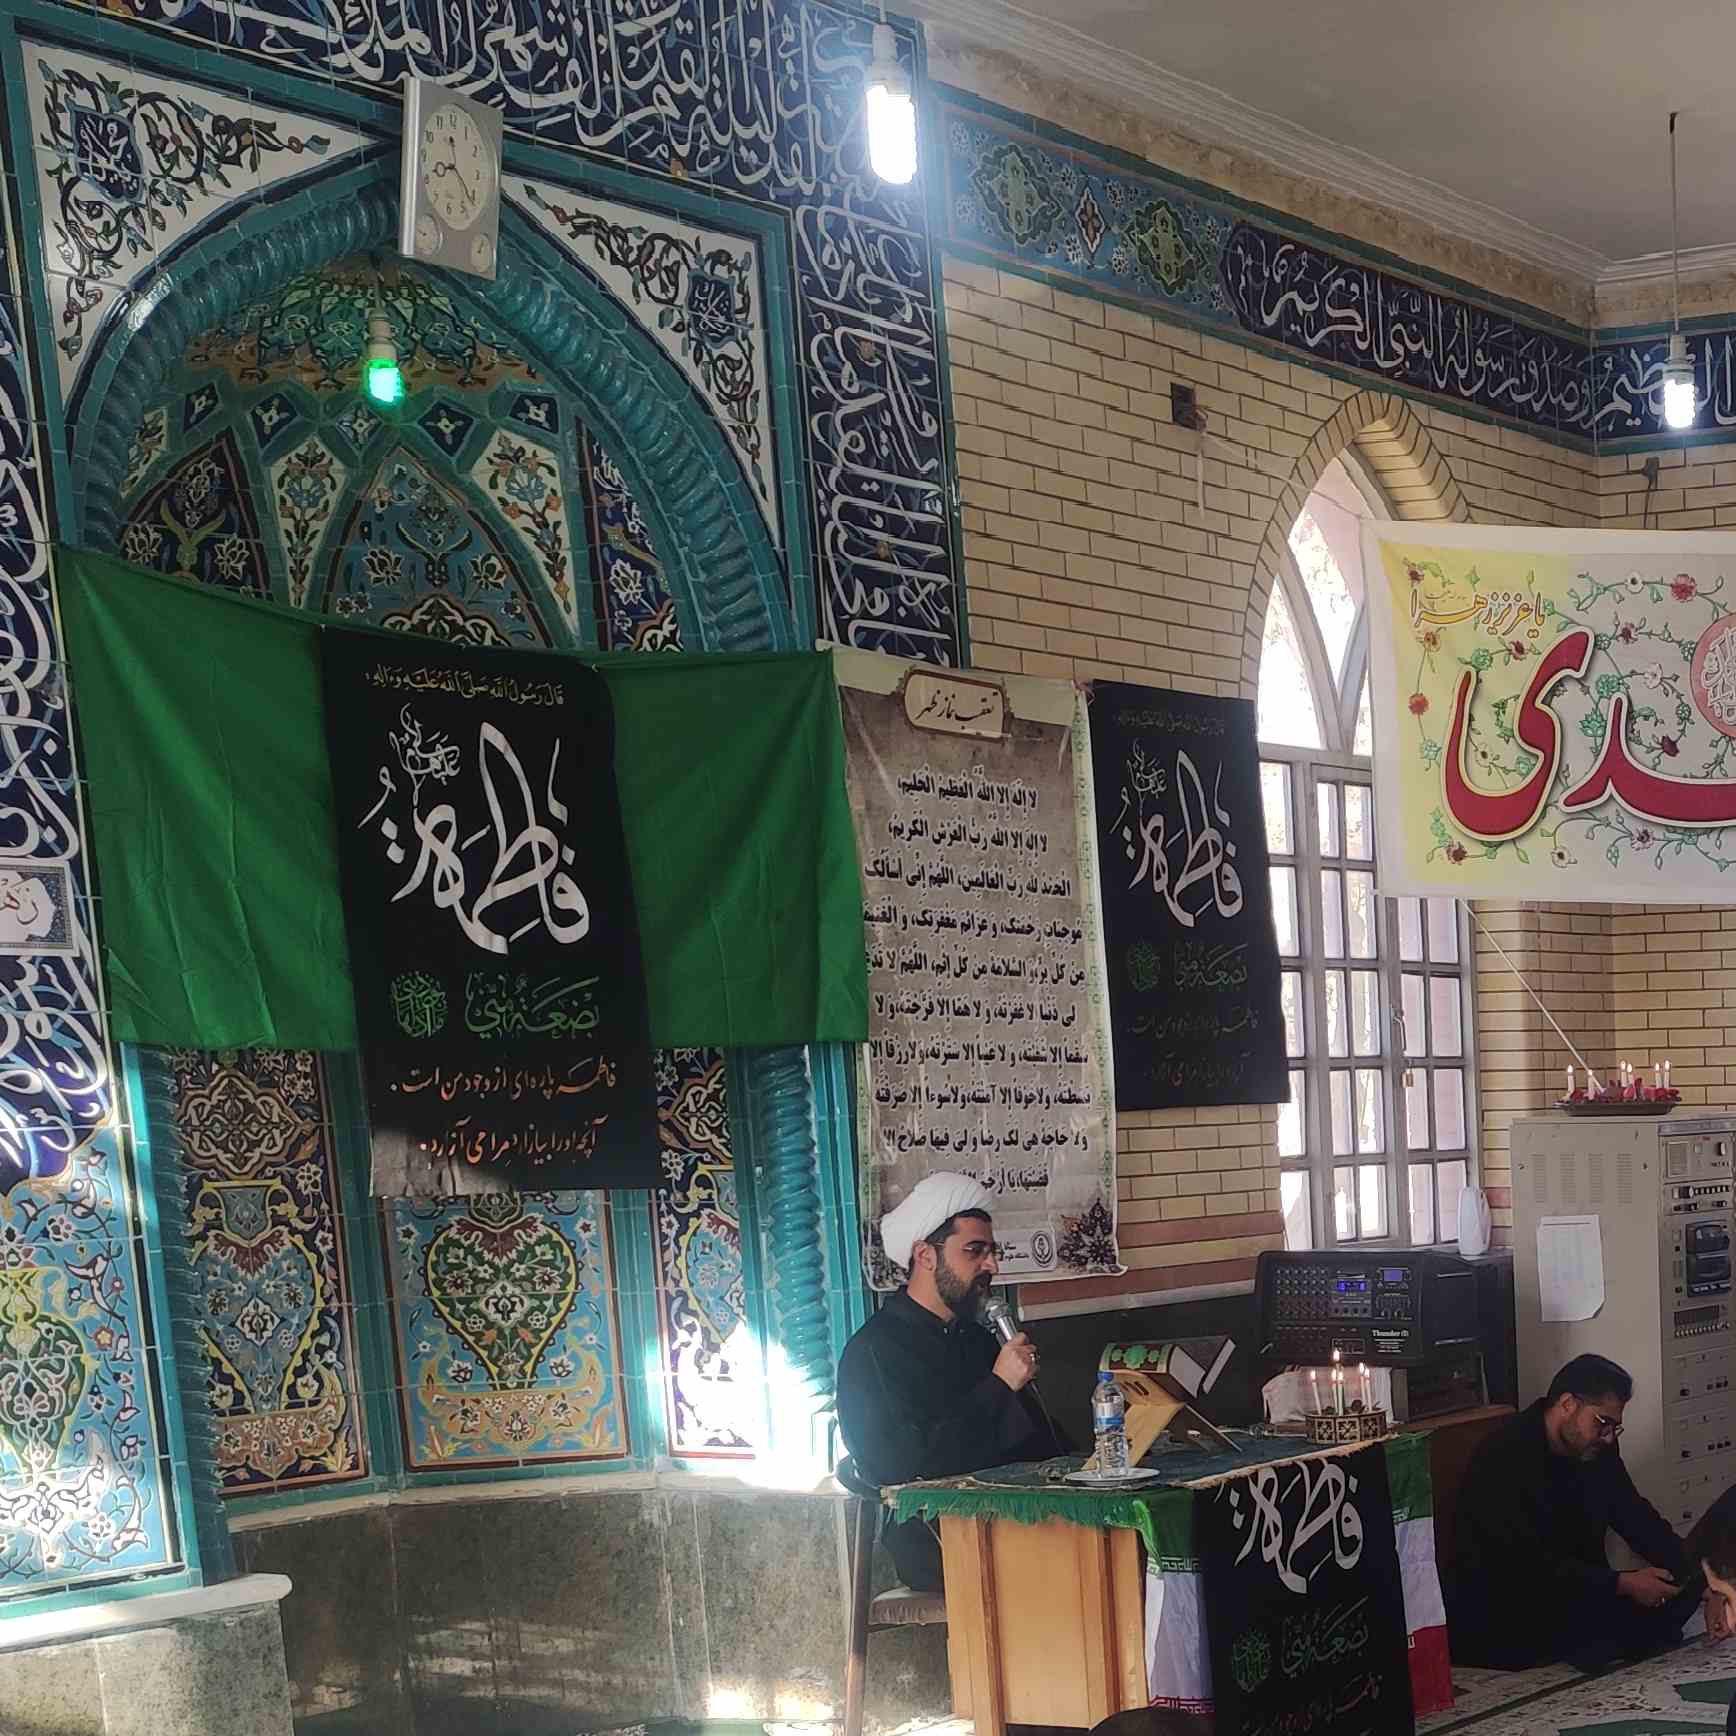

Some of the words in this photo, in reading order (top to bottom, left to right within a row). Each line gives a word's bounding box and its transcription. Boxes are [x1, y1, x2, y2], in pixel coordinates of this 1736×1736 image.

[435, 114, 444, 129] 11
[449, 112, 458, 130] 12
[1510, 345, 1580, 413] صدق
[1581, 336, 1733, 430] الظیم
[1410, 588, 1499, 629] زهرا
[1487, 592, 1534, 637] عزیز
[1527, 591, 1546, 639] یا
[914, 689, 940, 720] ظهر
[936, 693, 957, 721] نماز
[441, 1071, 463, 1101] من
[463, 1073, 492, 1100] وجود
